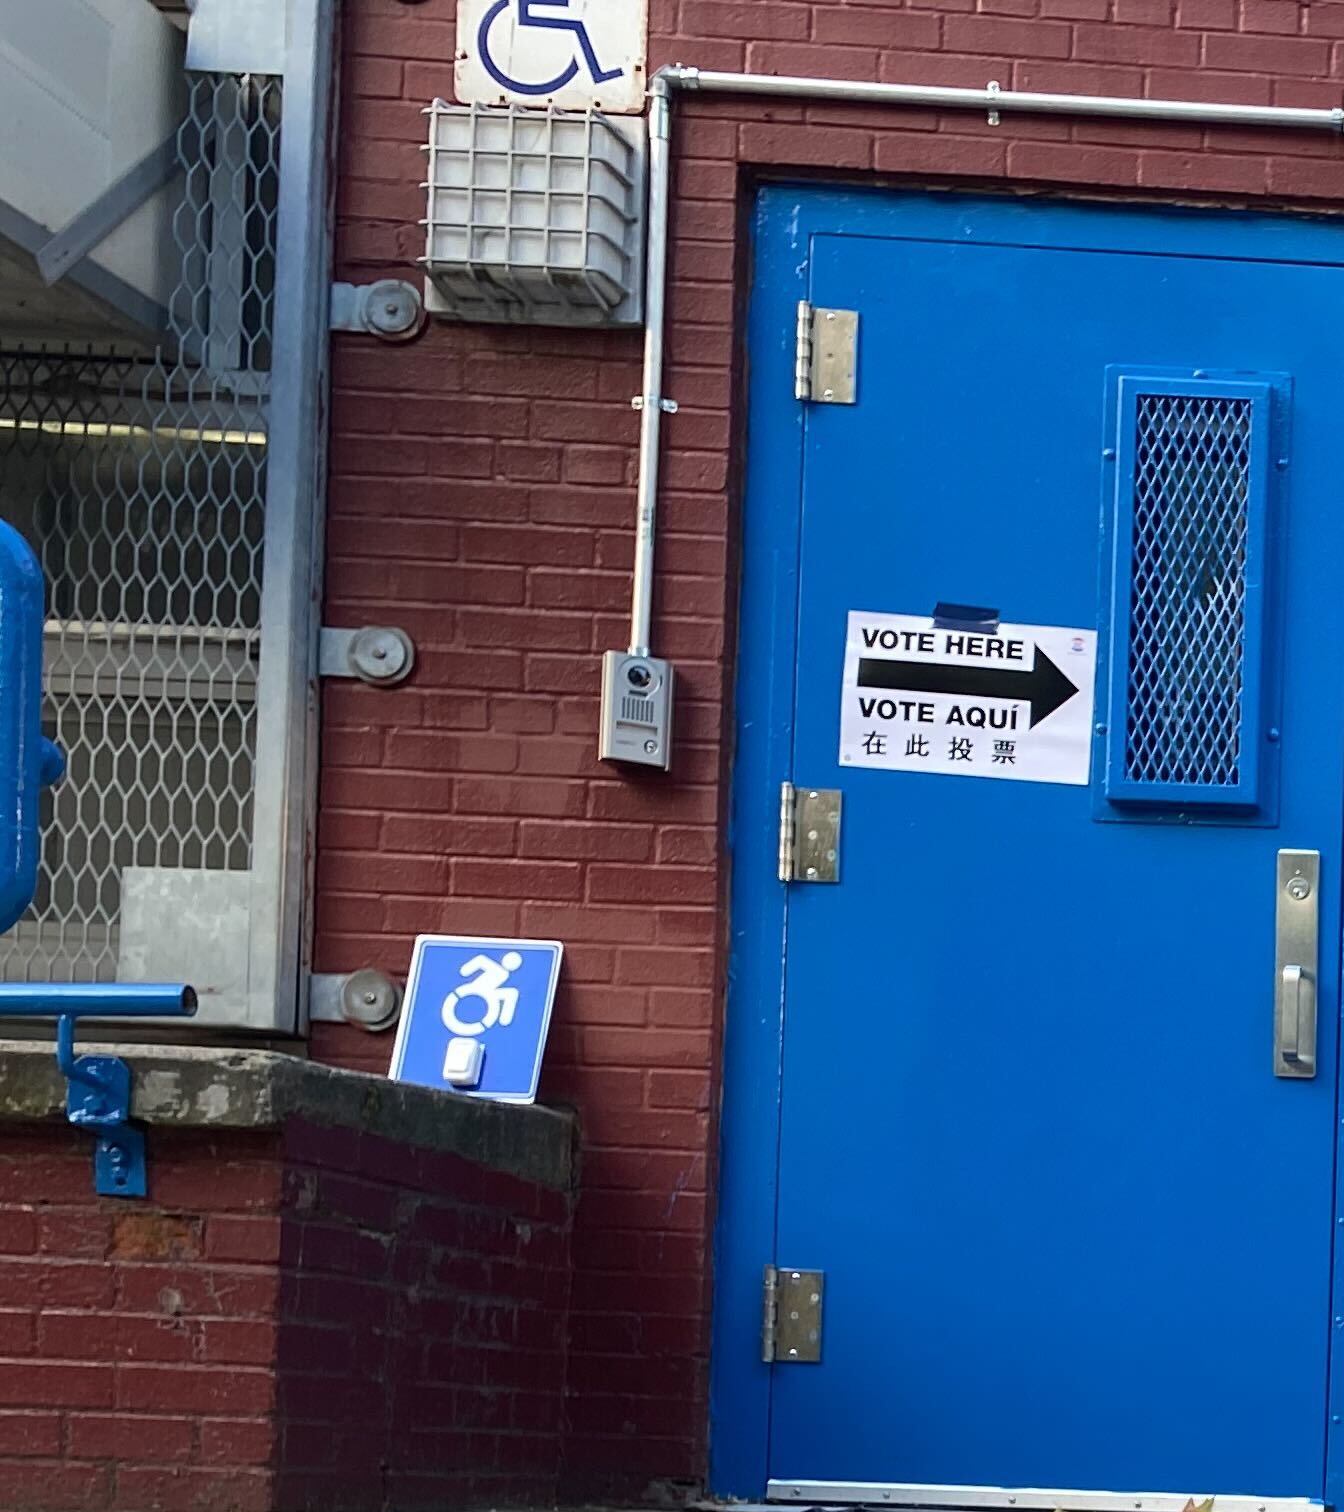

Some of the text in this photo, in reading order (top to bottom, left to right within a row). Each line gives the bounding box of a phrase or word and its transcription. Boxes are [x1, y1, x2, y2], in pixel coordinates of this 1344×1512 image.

[861, 628, 1024, 661] VOTE HERE
[858, 697, 1020, 731] VOTE AQUÍ
[861, 730, 1017, 765] 在此投票
